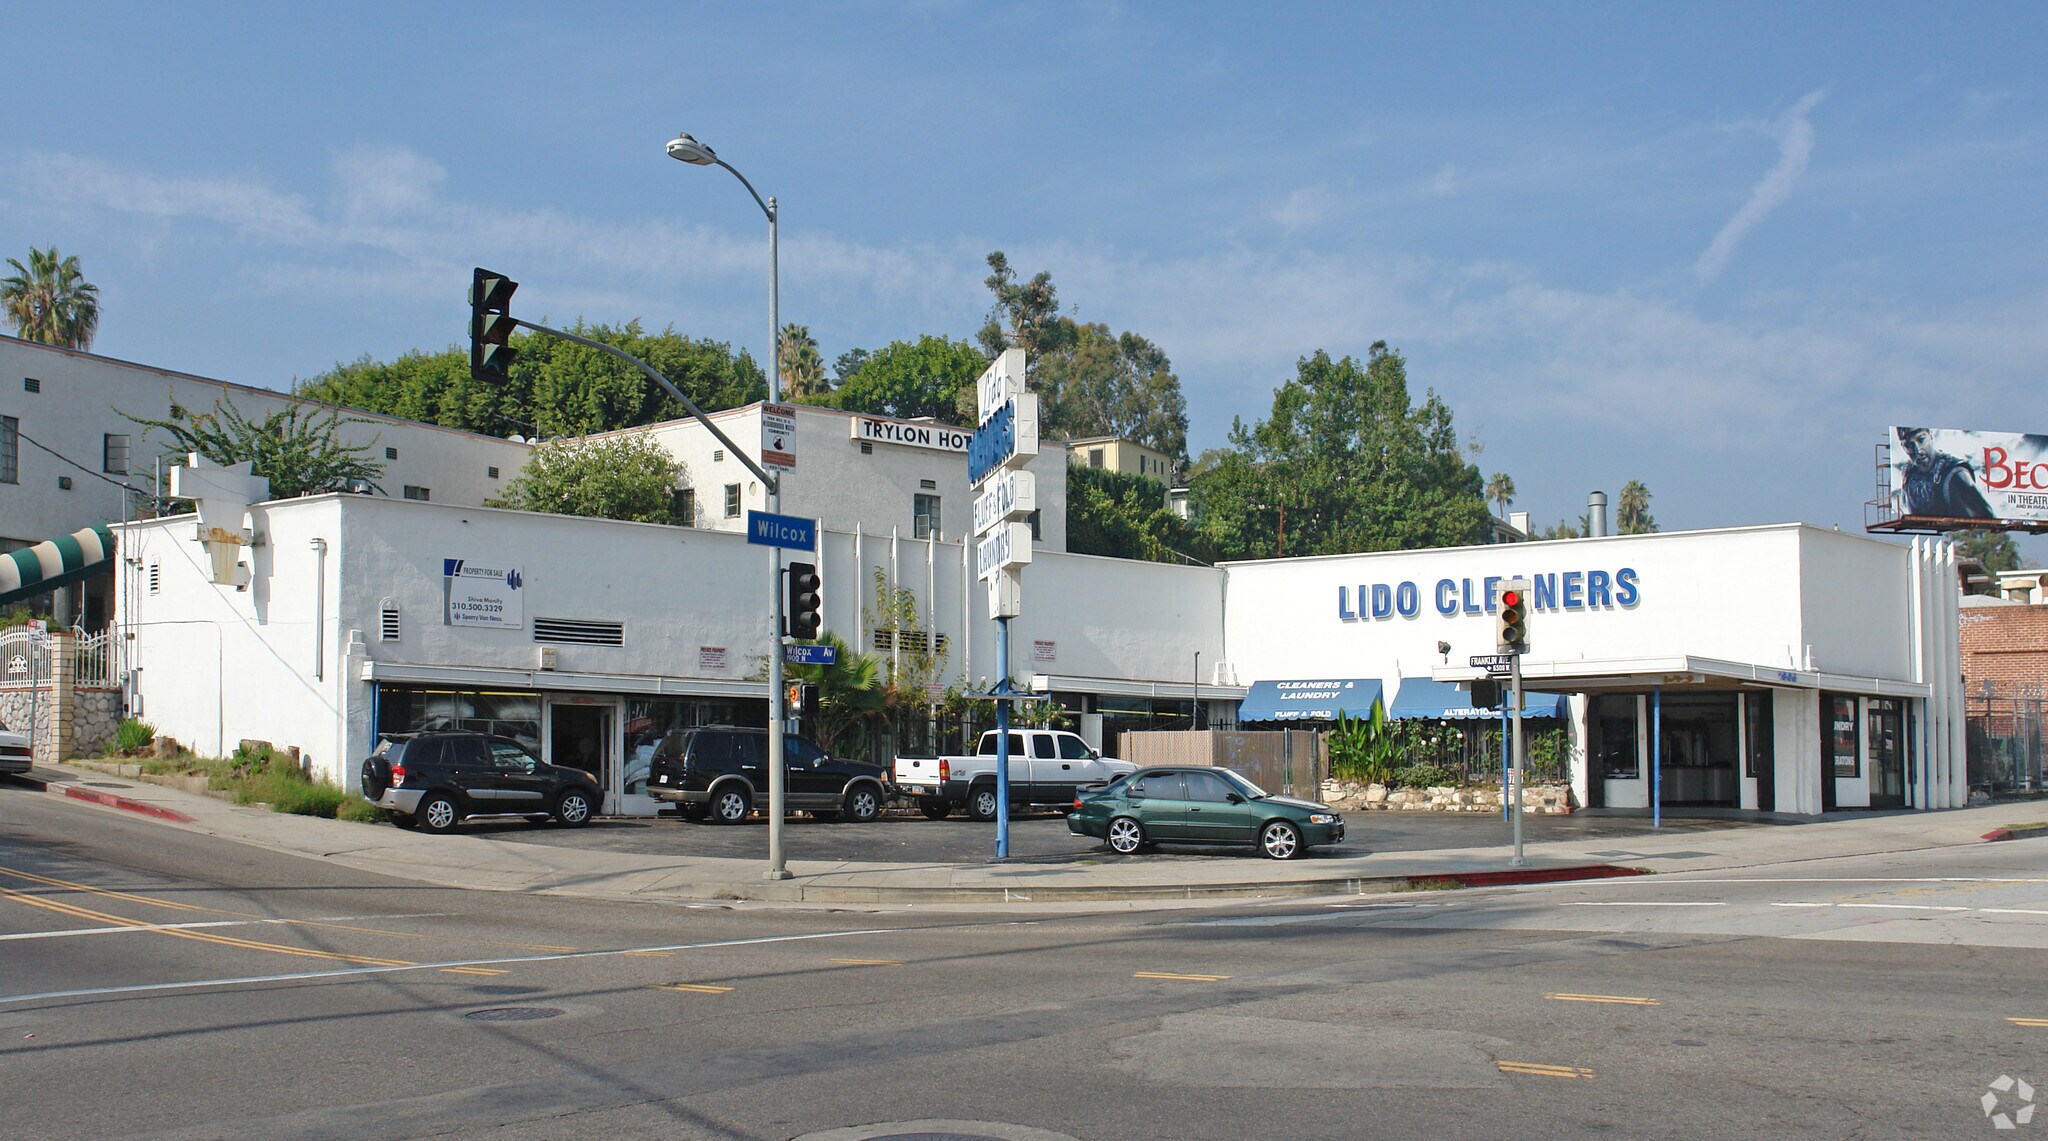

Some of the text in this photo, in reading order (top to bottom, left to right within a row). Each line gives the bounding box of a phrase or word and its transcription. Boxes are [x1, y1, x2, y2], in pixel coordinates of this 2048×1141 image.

[763, 405, 796, 417] WELCOME
[864, 421, 930, 445] TRYLON
[2008, 494, 2016, 503] IN
[758, 520, 806, 543] Wilcox
[979, 529, 1011, 575] LAUNDRY
[463, 567, 503, 577] PROPERTY FOR SALE
[1339, 567, 1639, 619] LIDO CLENERS
[452, 602, 503, 612] 310.500.3329
[786, 645, 833, 657] Wilcox Av
[1470, 656, 1497, 666] FRANKLIN
[1276, 681, 1341, 690] CLEANERS
[1281, 691, 1341, 700] LAUNDRY
[1310, 710, 1332, 718] FOLD
